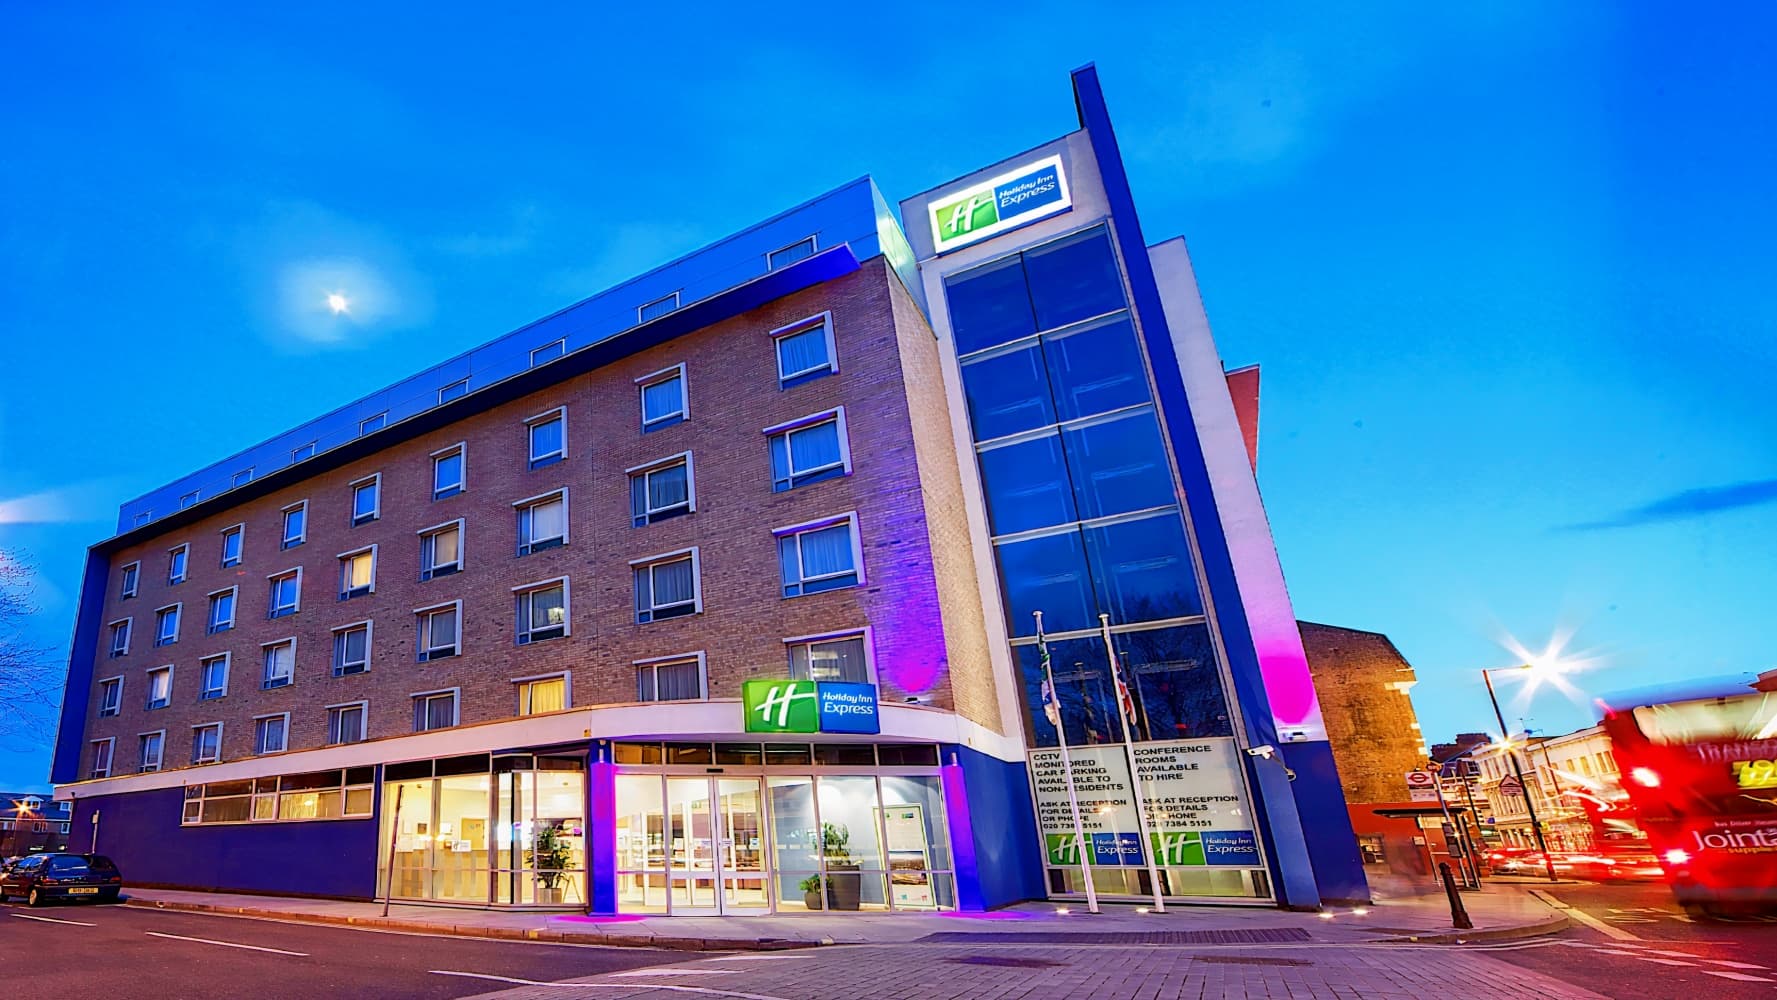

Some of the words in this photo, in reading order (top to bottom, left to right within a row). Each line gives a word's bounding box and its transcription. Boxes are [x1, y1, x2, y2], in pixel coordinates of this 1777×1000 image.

[999, 181, 1036, 199] Holiday
[1037, 174, 1054, 185] Inn
[1001, 181, 1056, 208] Express
[823, 691, 858, 704] Holiday
[858, 694, 873, 703] Inn
[824, 702, 873, 715] Express
[1133, 745, 1212, 756] CONFERENCE
[1033, 753, 1060, 761] CCTV
[1135, 755, 1177, 764] ROOMS
[1137, 763, 1199, 773] AVAILABLE
[1036, 769, 1058, 777] CAR
[1156, 773, 1184, 781] HIRE
[1038, 776, 1095, 784] AVAILBLE
[1179, 795, 1239, 803] RECEPTION
[1165, 804, 1208, 812] DETAILS
[1206, 837, 1238, 845] Holiday
[1207, 844, 1254, 855] Express
